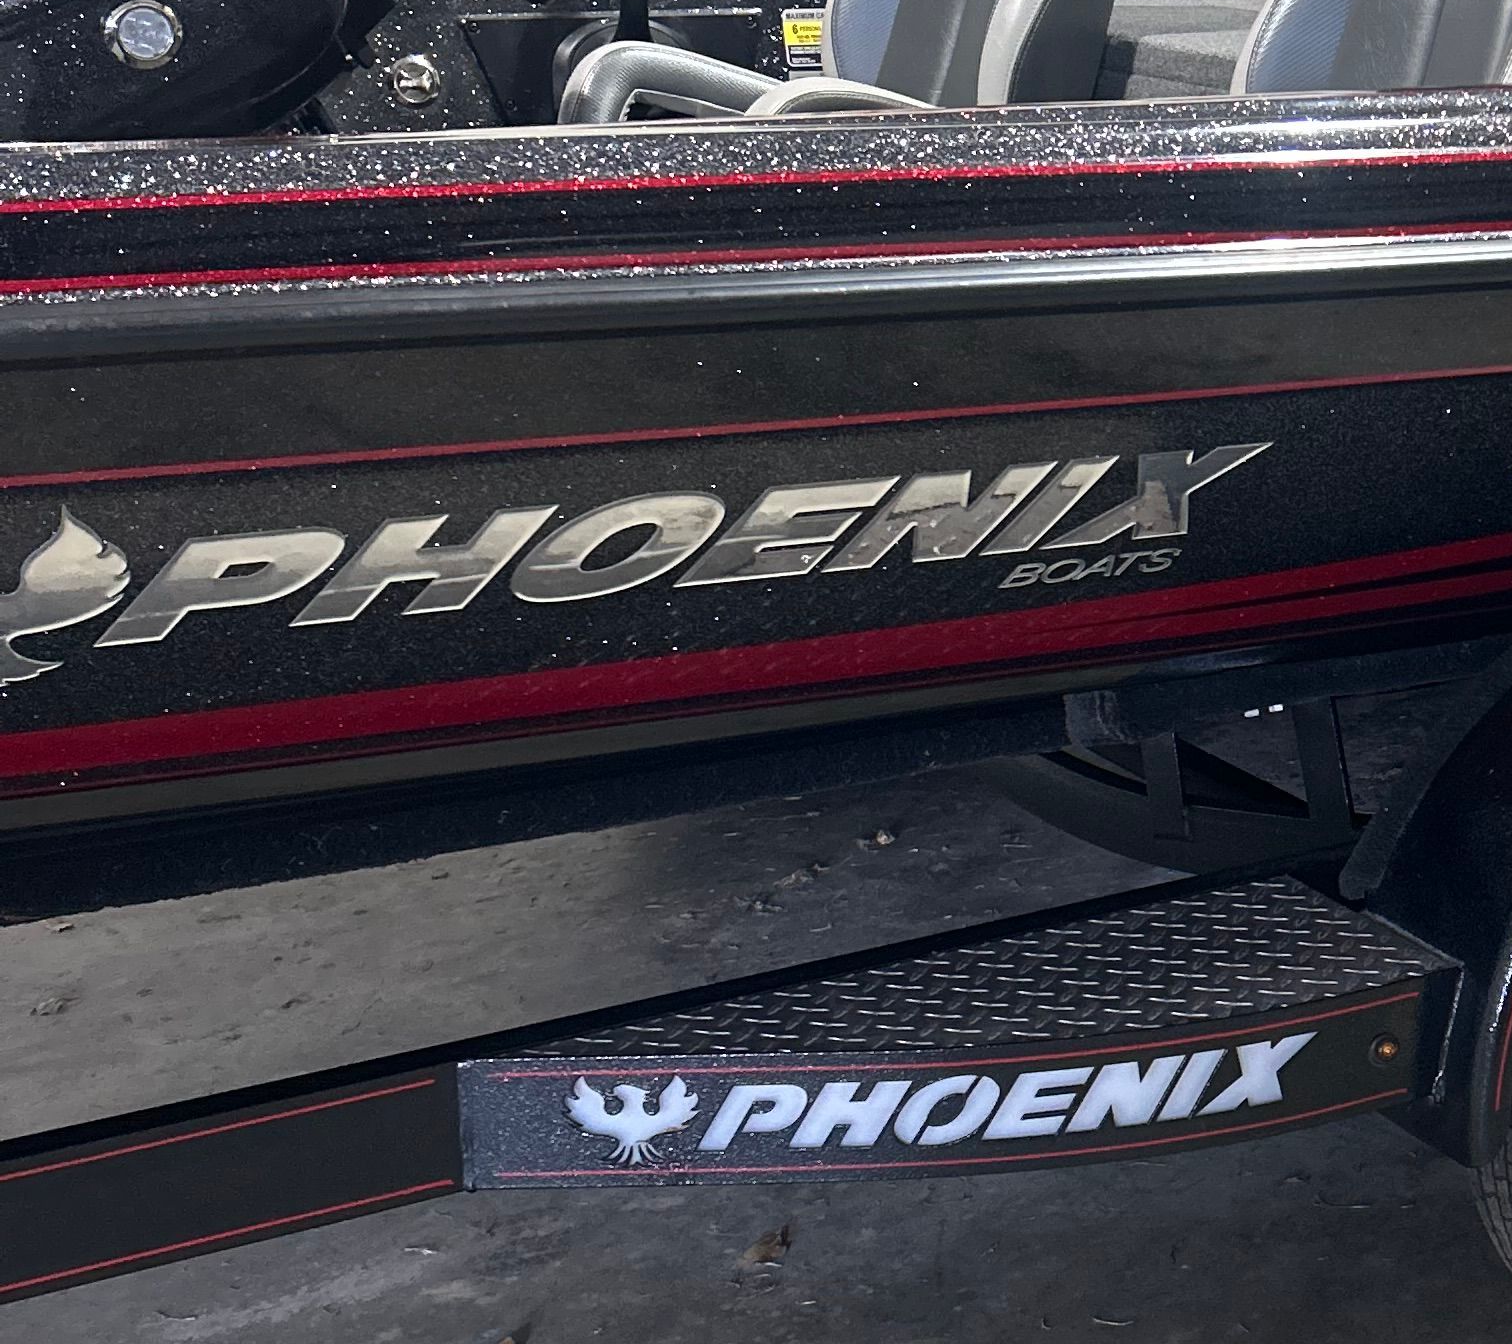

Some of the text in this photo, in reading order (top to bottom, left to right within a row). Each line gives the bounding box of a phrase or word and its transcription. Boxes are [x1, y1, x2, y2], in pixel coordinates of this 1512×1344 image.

[792, 23, 799, 34] 6
[93, 442, 1275, 648] PHOENIX
[998, 547, 1183, 589] BOATS
[695, 1031, 1319, 1151] PHOENIX
